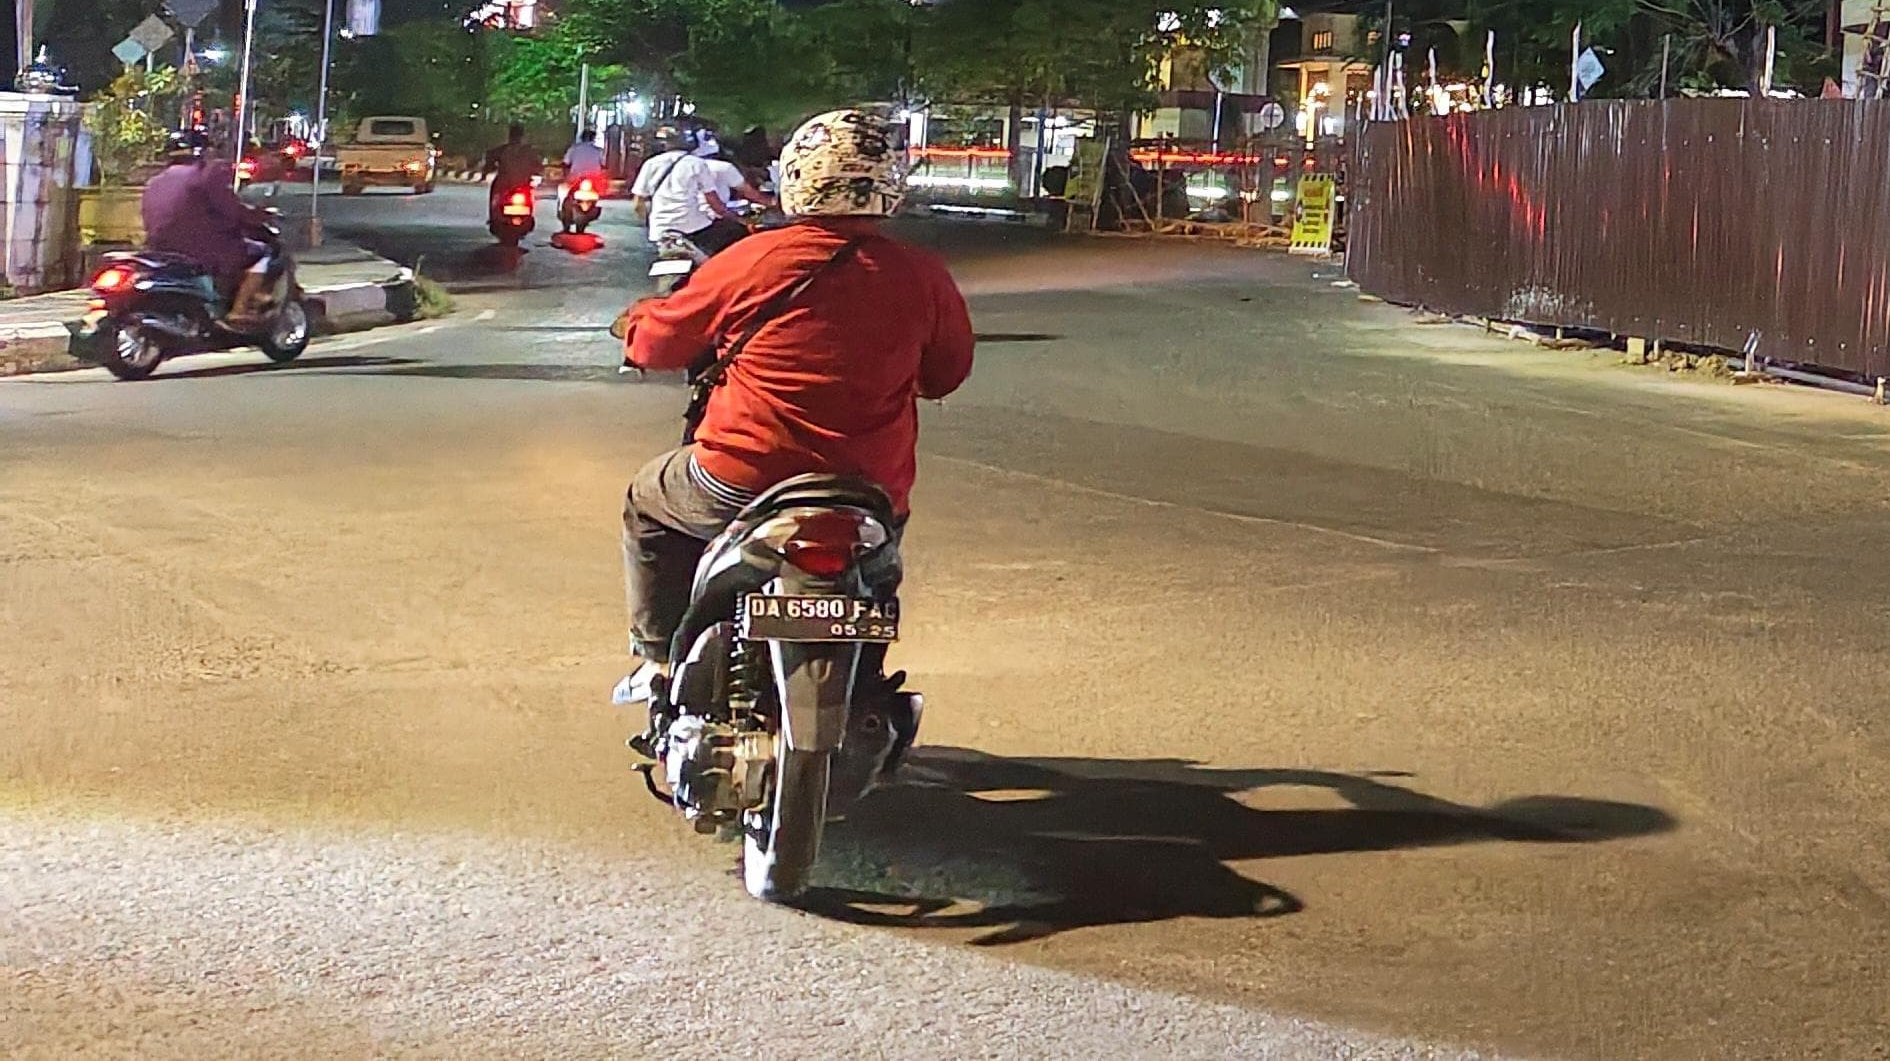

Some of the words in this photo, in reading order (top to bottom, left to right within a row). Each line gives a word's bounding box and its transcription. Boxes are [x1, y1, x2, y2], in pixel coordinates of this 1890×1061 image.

[752, 599, 780, 618] DA
[787, 599, 845, 618] 6580
[830, 623, 896, 638] 05-25
